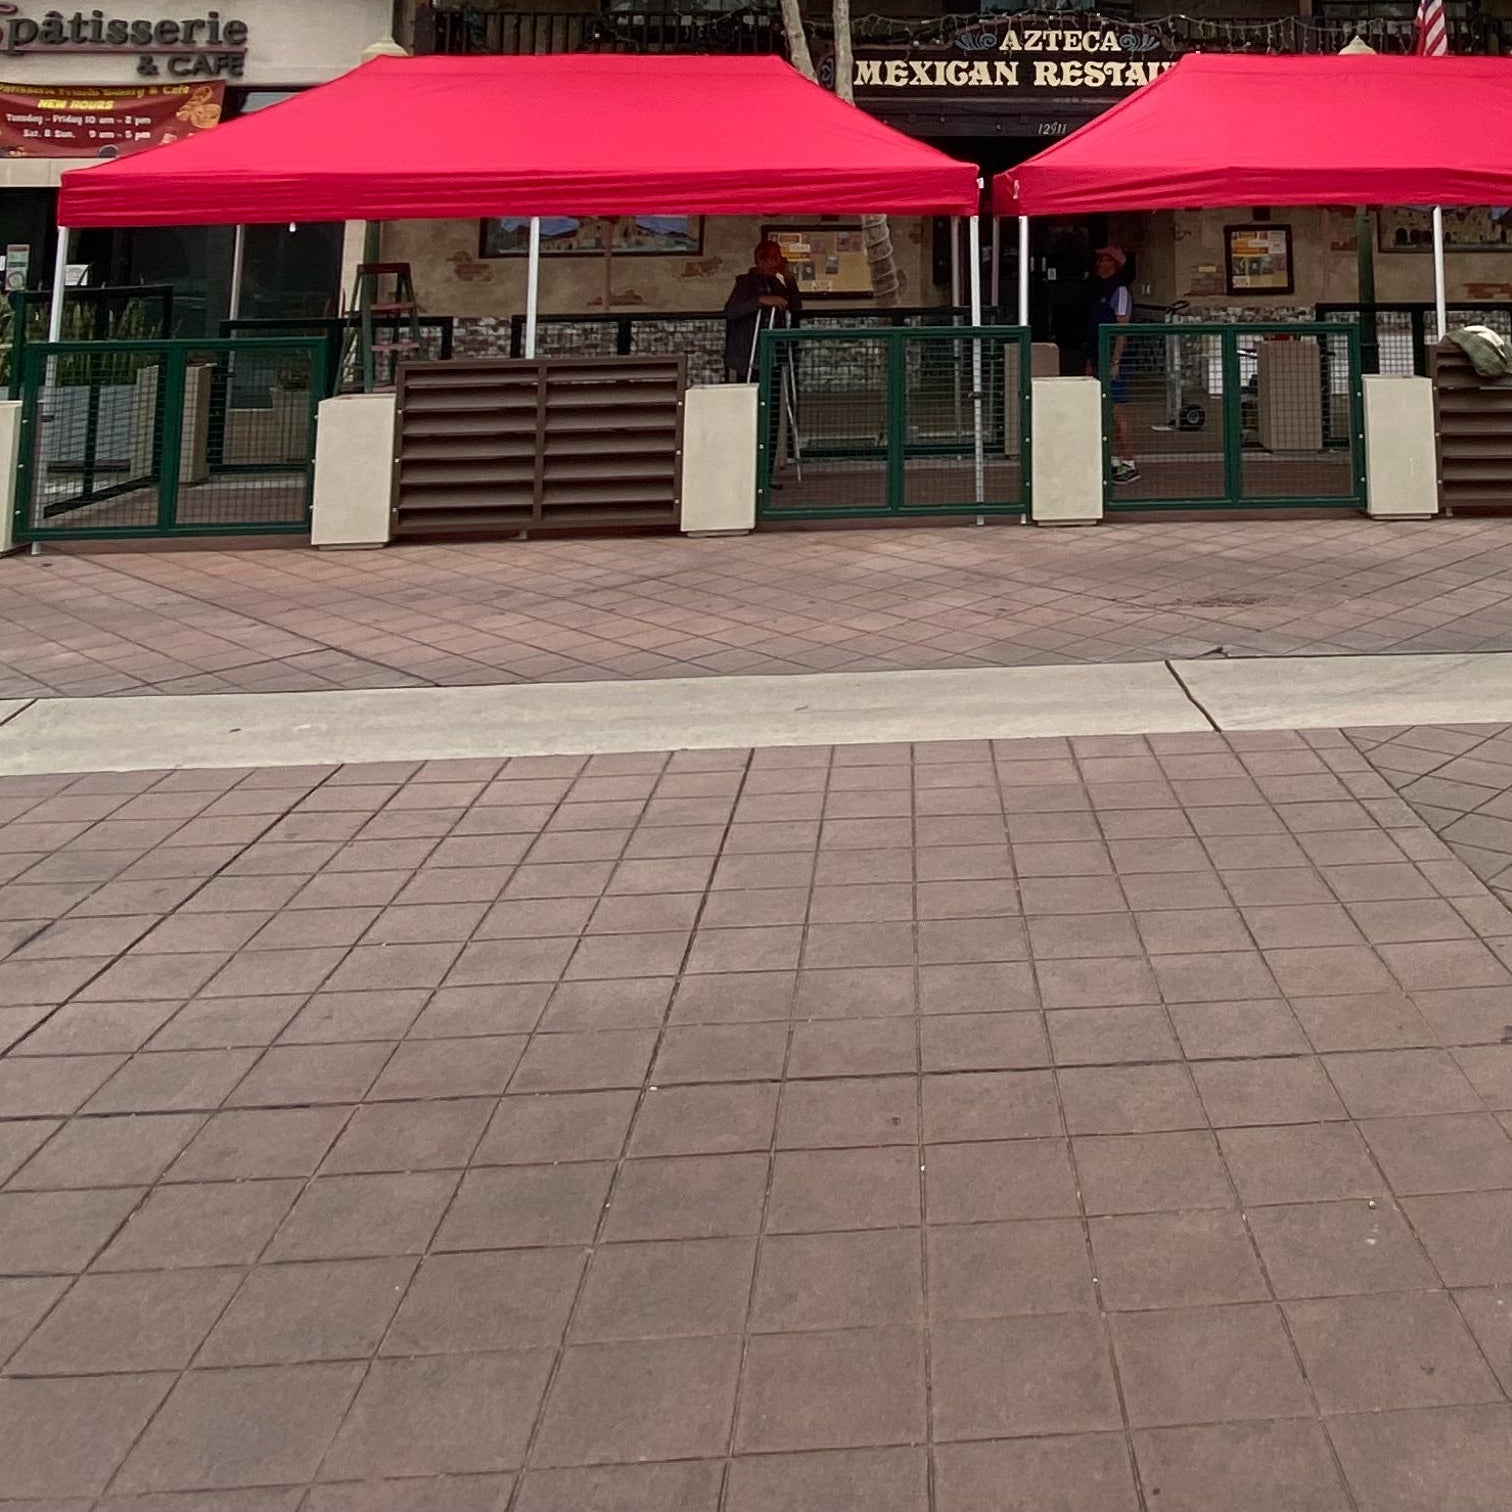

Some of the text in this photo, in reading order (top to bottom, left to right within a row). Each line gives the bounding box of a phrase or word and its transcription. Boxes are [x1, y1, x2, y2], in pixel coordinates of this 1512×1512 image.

[5, 10, 248, 55] pâtisserie
[999, 30, 1122, 52] AZTECA
[137, 53, 244, 77] & CAFE
[853, 60, 1177, 87] MEXICAN RESTAU
[38, 99, 115, 110] NEW HOURS
[6, 114, 43, 125] Tuesday
[52, 114, 82, 126] Friday
[85, 115, 96, 124] 10
[135, 117, 150, 126] pm
[135, 131, 150, 141] pm
